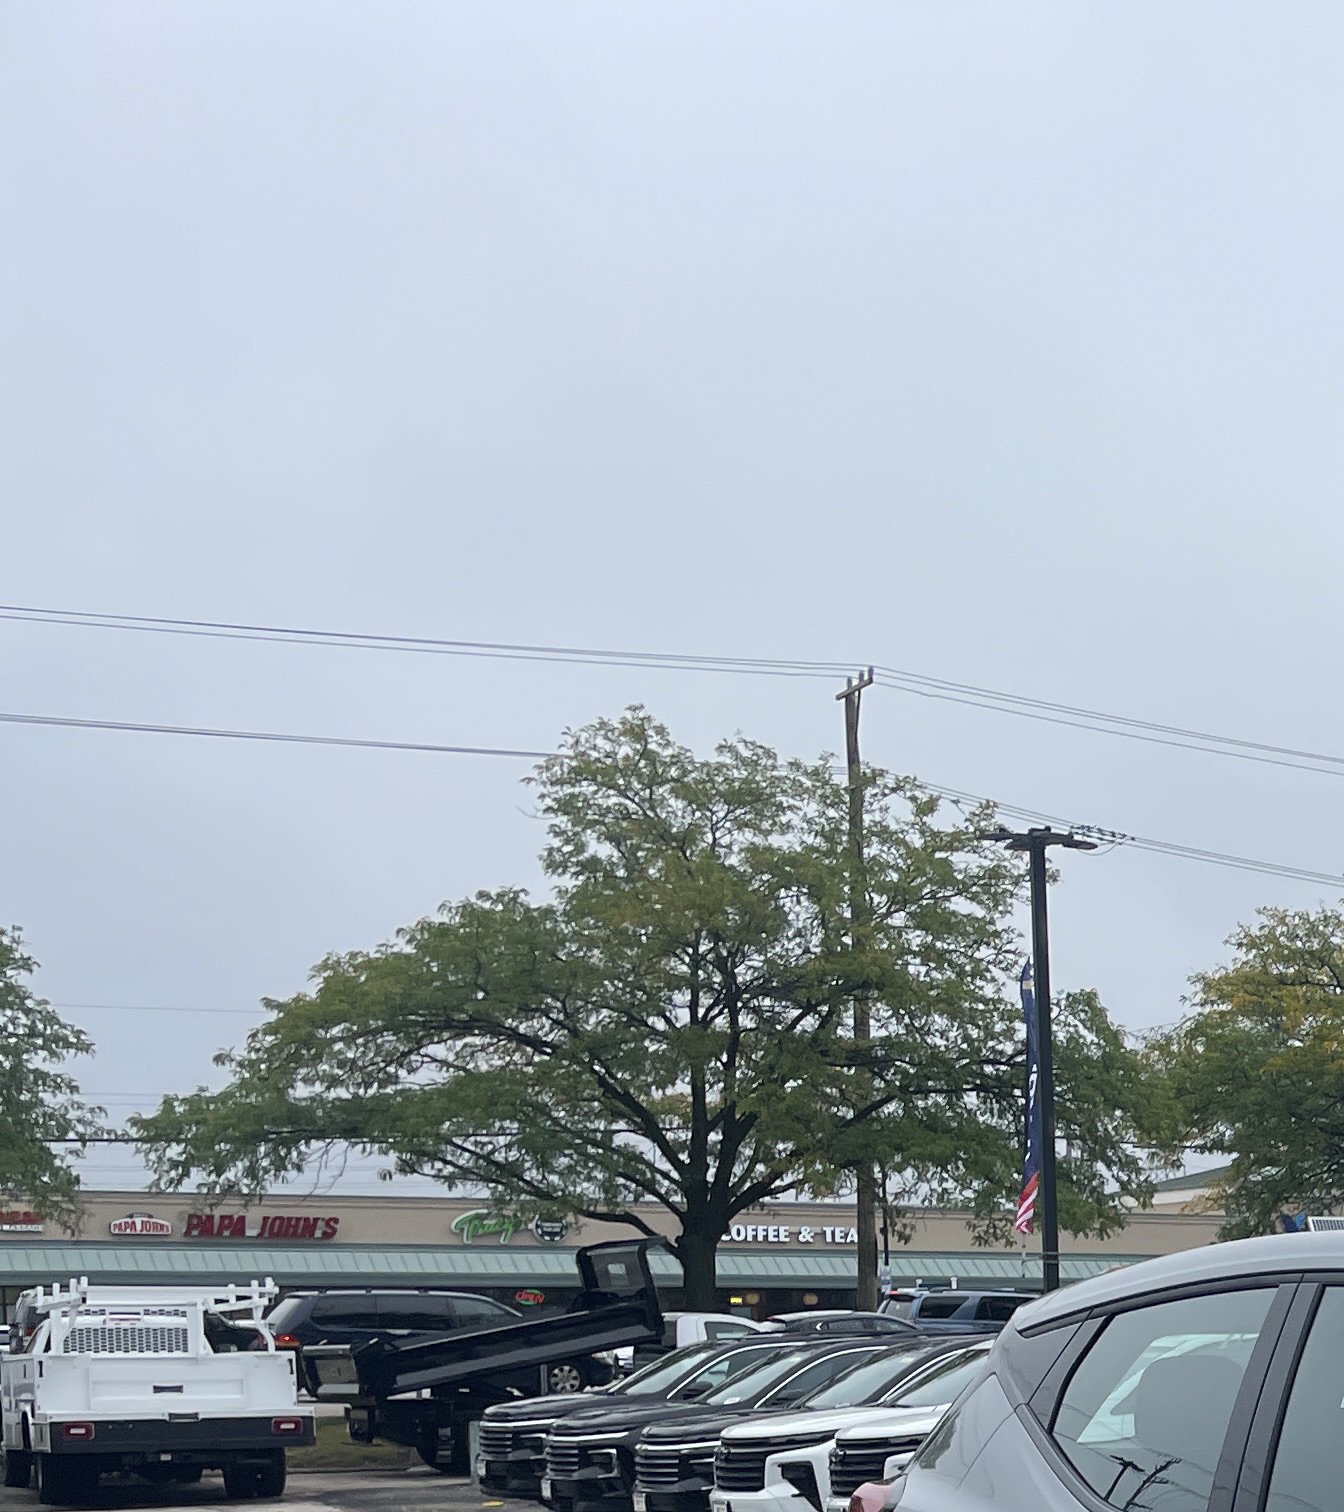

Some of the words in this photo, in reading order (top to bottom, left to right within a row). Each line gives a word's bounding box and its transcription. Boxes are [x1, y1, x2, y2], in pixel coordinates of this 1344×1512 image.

[184, 1214, 246, 1238] PAPA
[257, 1216, 339, 1240] JOHN'S
[798, 1226, 814, 1243] &
[823, 1227, 858, 1243] TEA
